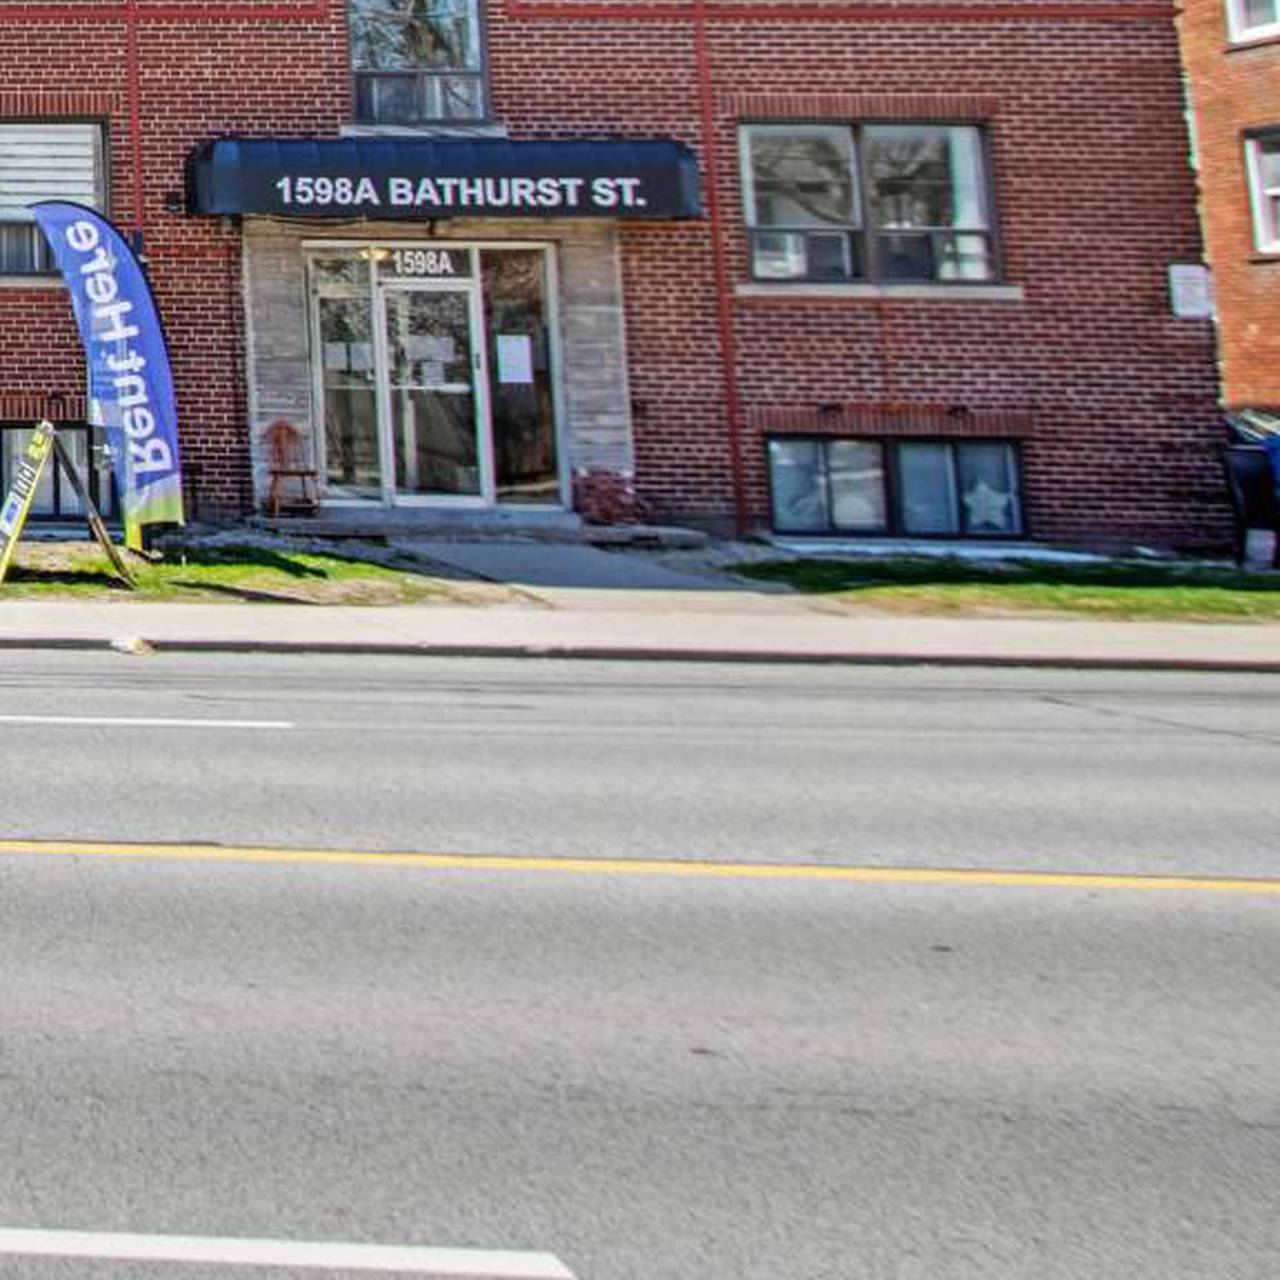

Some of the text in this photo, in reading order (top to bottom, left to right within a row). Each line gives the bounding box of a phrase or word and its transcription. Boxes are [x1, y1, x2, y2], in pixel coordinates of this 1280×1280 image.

[276, 177, 647, 208] 1598A BATHURST ST.
[392, 250, 454, 275] 1598A
